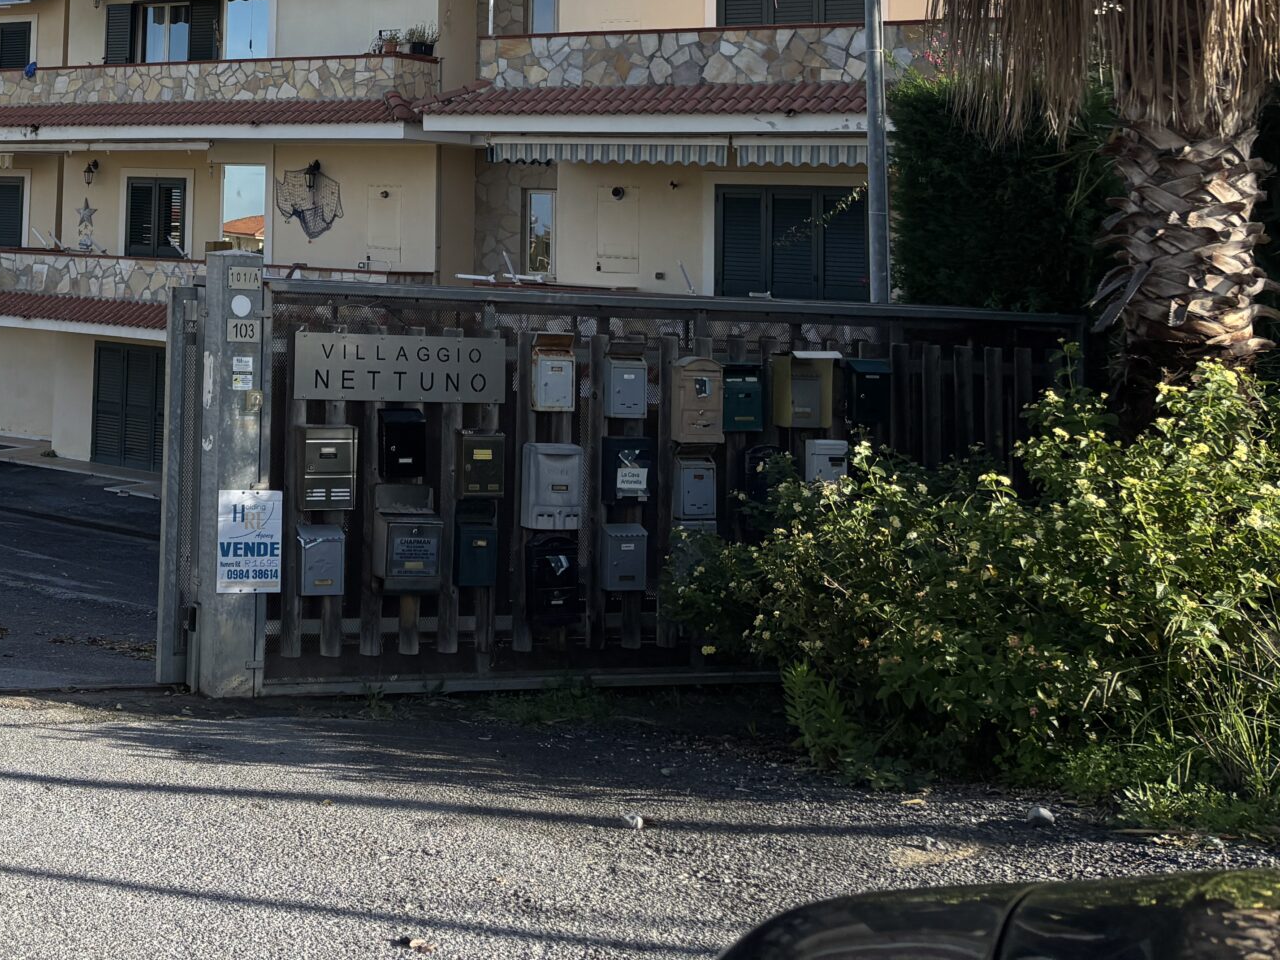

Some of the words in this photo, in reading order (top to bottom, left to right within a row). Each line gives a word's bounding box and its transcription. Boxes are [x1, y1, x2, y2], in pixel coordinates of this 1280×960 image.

[230, 272, 259, 283] 101/A
[232, 323, 255, 339] 103
[321, 343, 482, 364] VILLAGGIO
[314, 369, 487, 393] NETTUNO
[220, 542, 280, 558] VENDE
[227, 569, 250, 580] 0984
[252, 569, 279, 580] 38614
